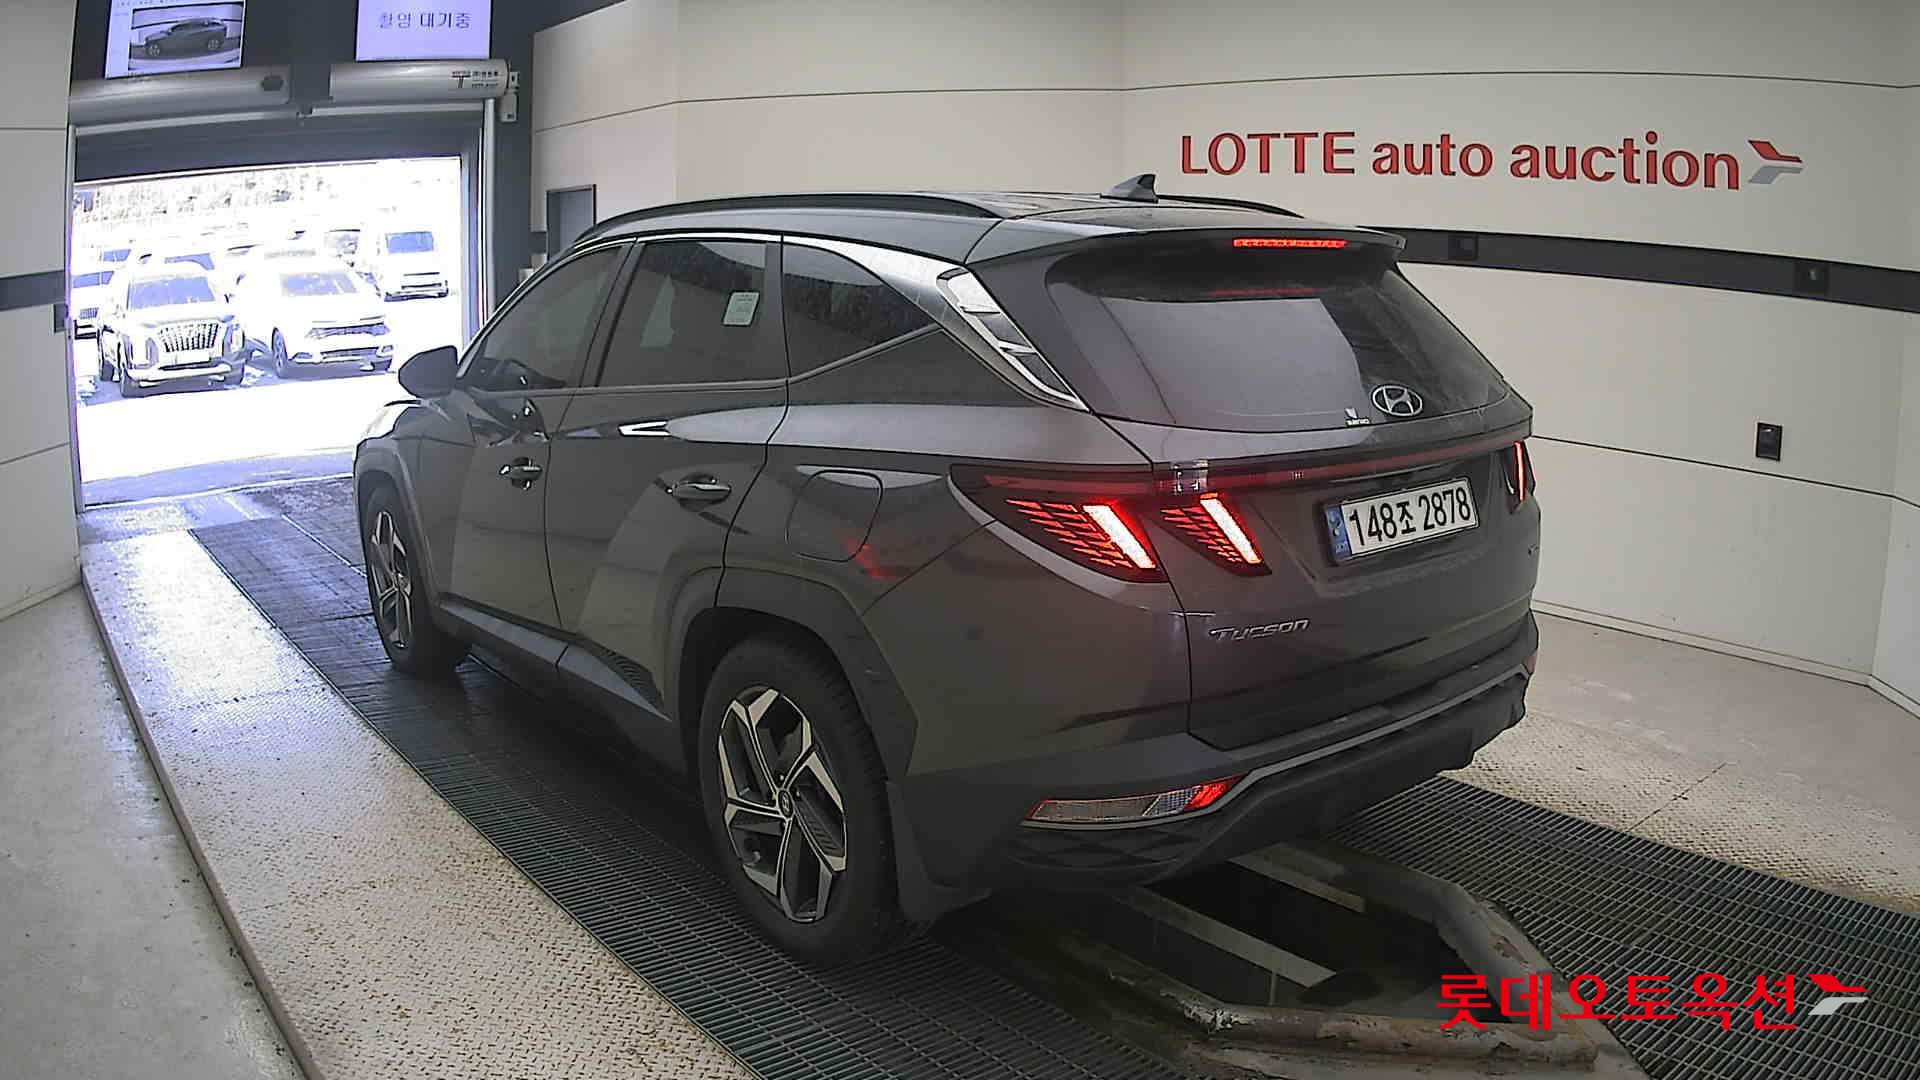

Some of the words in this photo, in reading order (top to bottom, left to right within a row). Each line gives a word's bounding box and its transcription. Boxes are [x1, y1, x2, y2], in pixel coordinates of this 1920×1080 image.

[419, 11, 471, 29] 대기중
[1181, 131, 1355, 176] LOTTE
[1371, 134, 1494, 178] auto
[1509, 130, 1740, 190] auction
[1349, 501, 1417, 546] 148조
[1418, 486, 1471, 531] 2878
